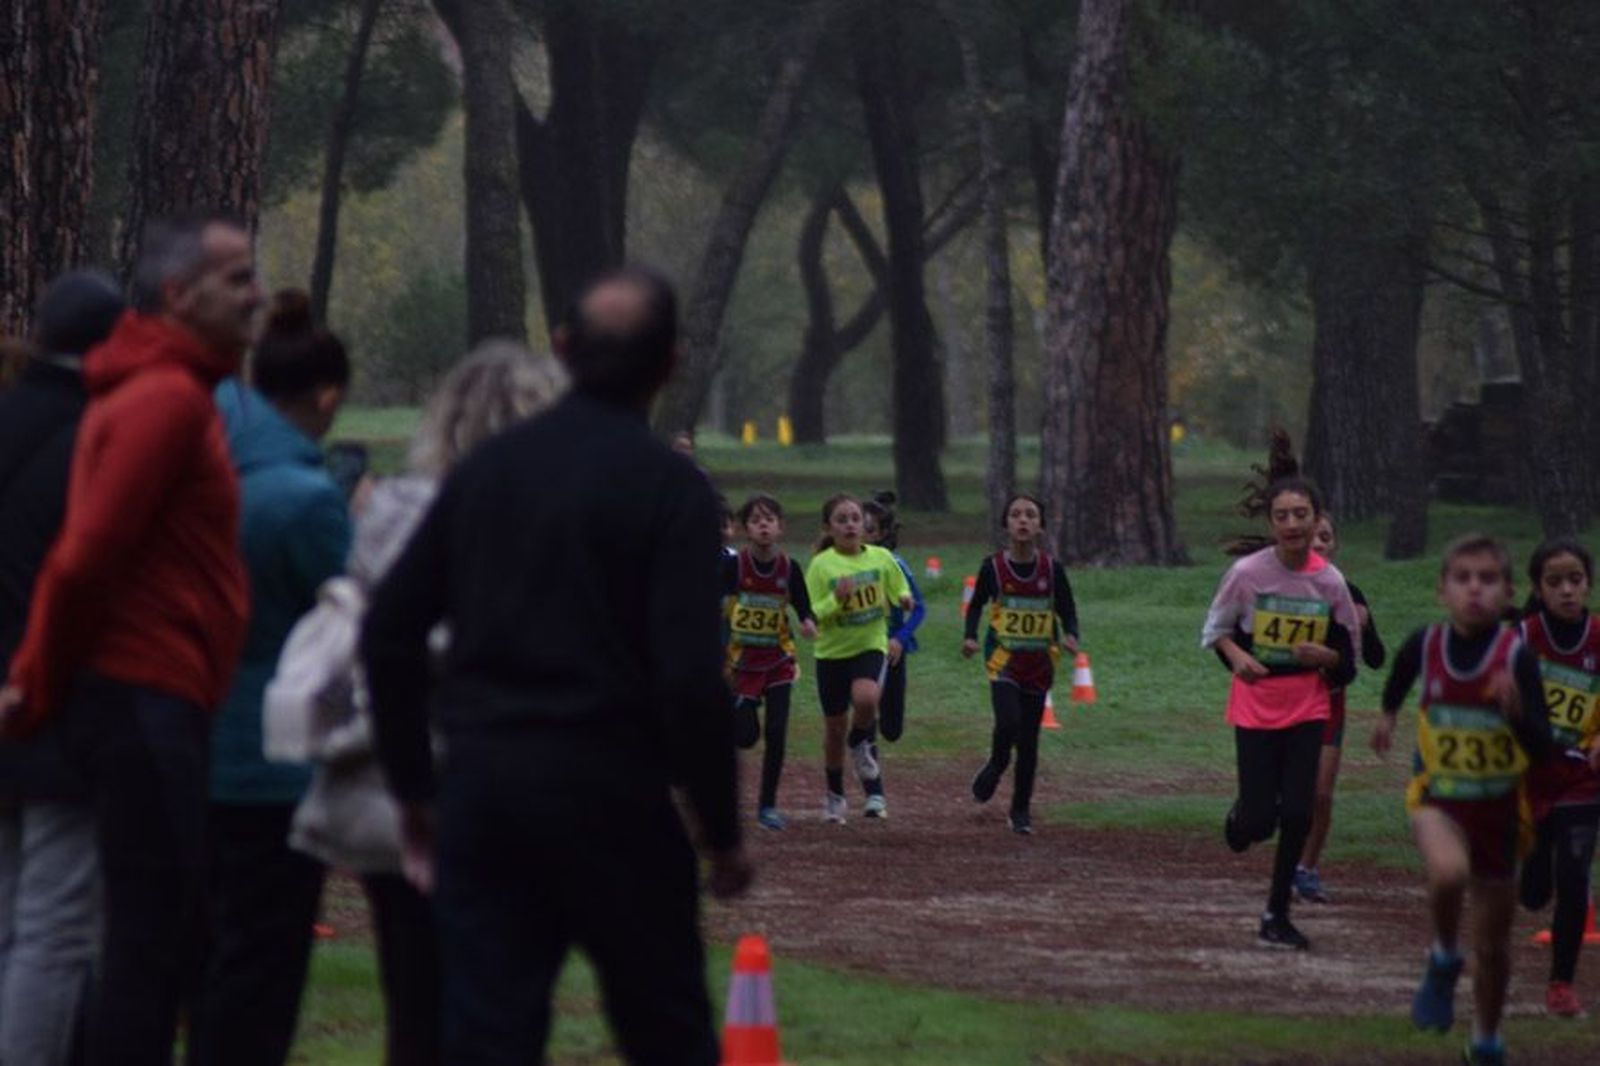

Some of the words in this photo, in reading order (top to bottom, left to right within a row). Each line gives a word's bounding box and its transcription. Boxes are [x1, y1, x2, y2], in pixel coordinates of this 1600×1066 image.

[736, 609, 780, 631] 234
[1005, 612, 1047, 634] 207
[1264, 617, 1316, 644] 471
[1438, 734, 1515, 771] 233
